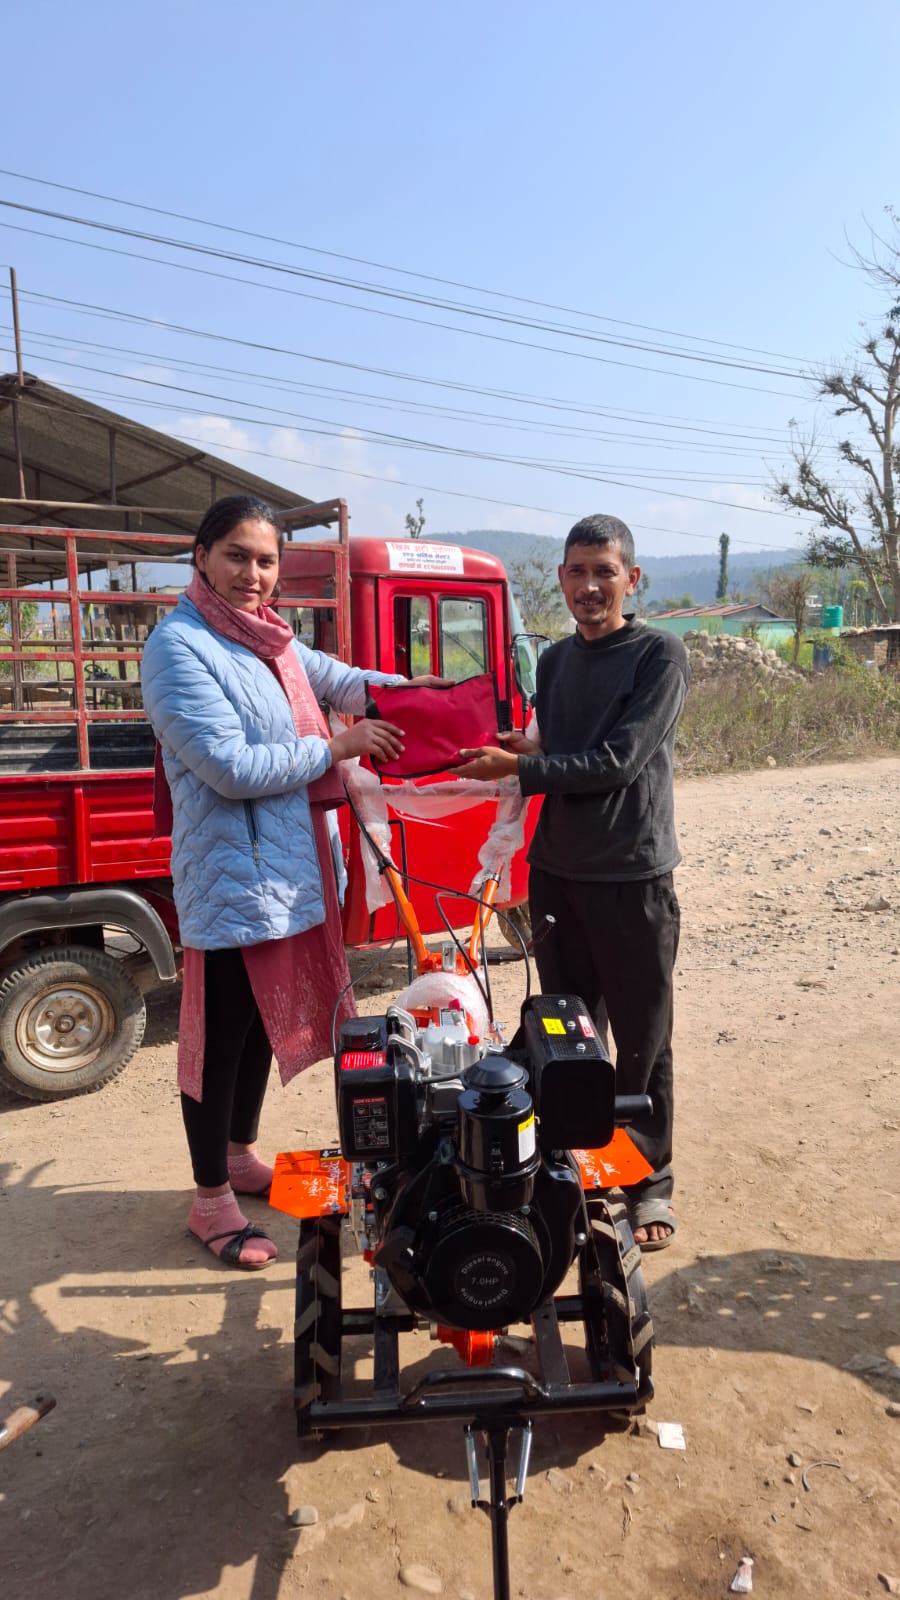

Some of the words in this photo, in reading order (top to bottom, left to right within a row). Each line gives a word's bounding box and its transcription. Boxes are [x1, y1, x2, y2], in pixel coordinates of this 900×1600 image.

[461, 1256, 485, 1274] Diesel
[486, 1257, 509, 1275] engine
[471, 1276, 499, 1286] 7.0HP
[460, 1287, 483, 1306] engine
[484, 1288, 509, 1306] Diesel
